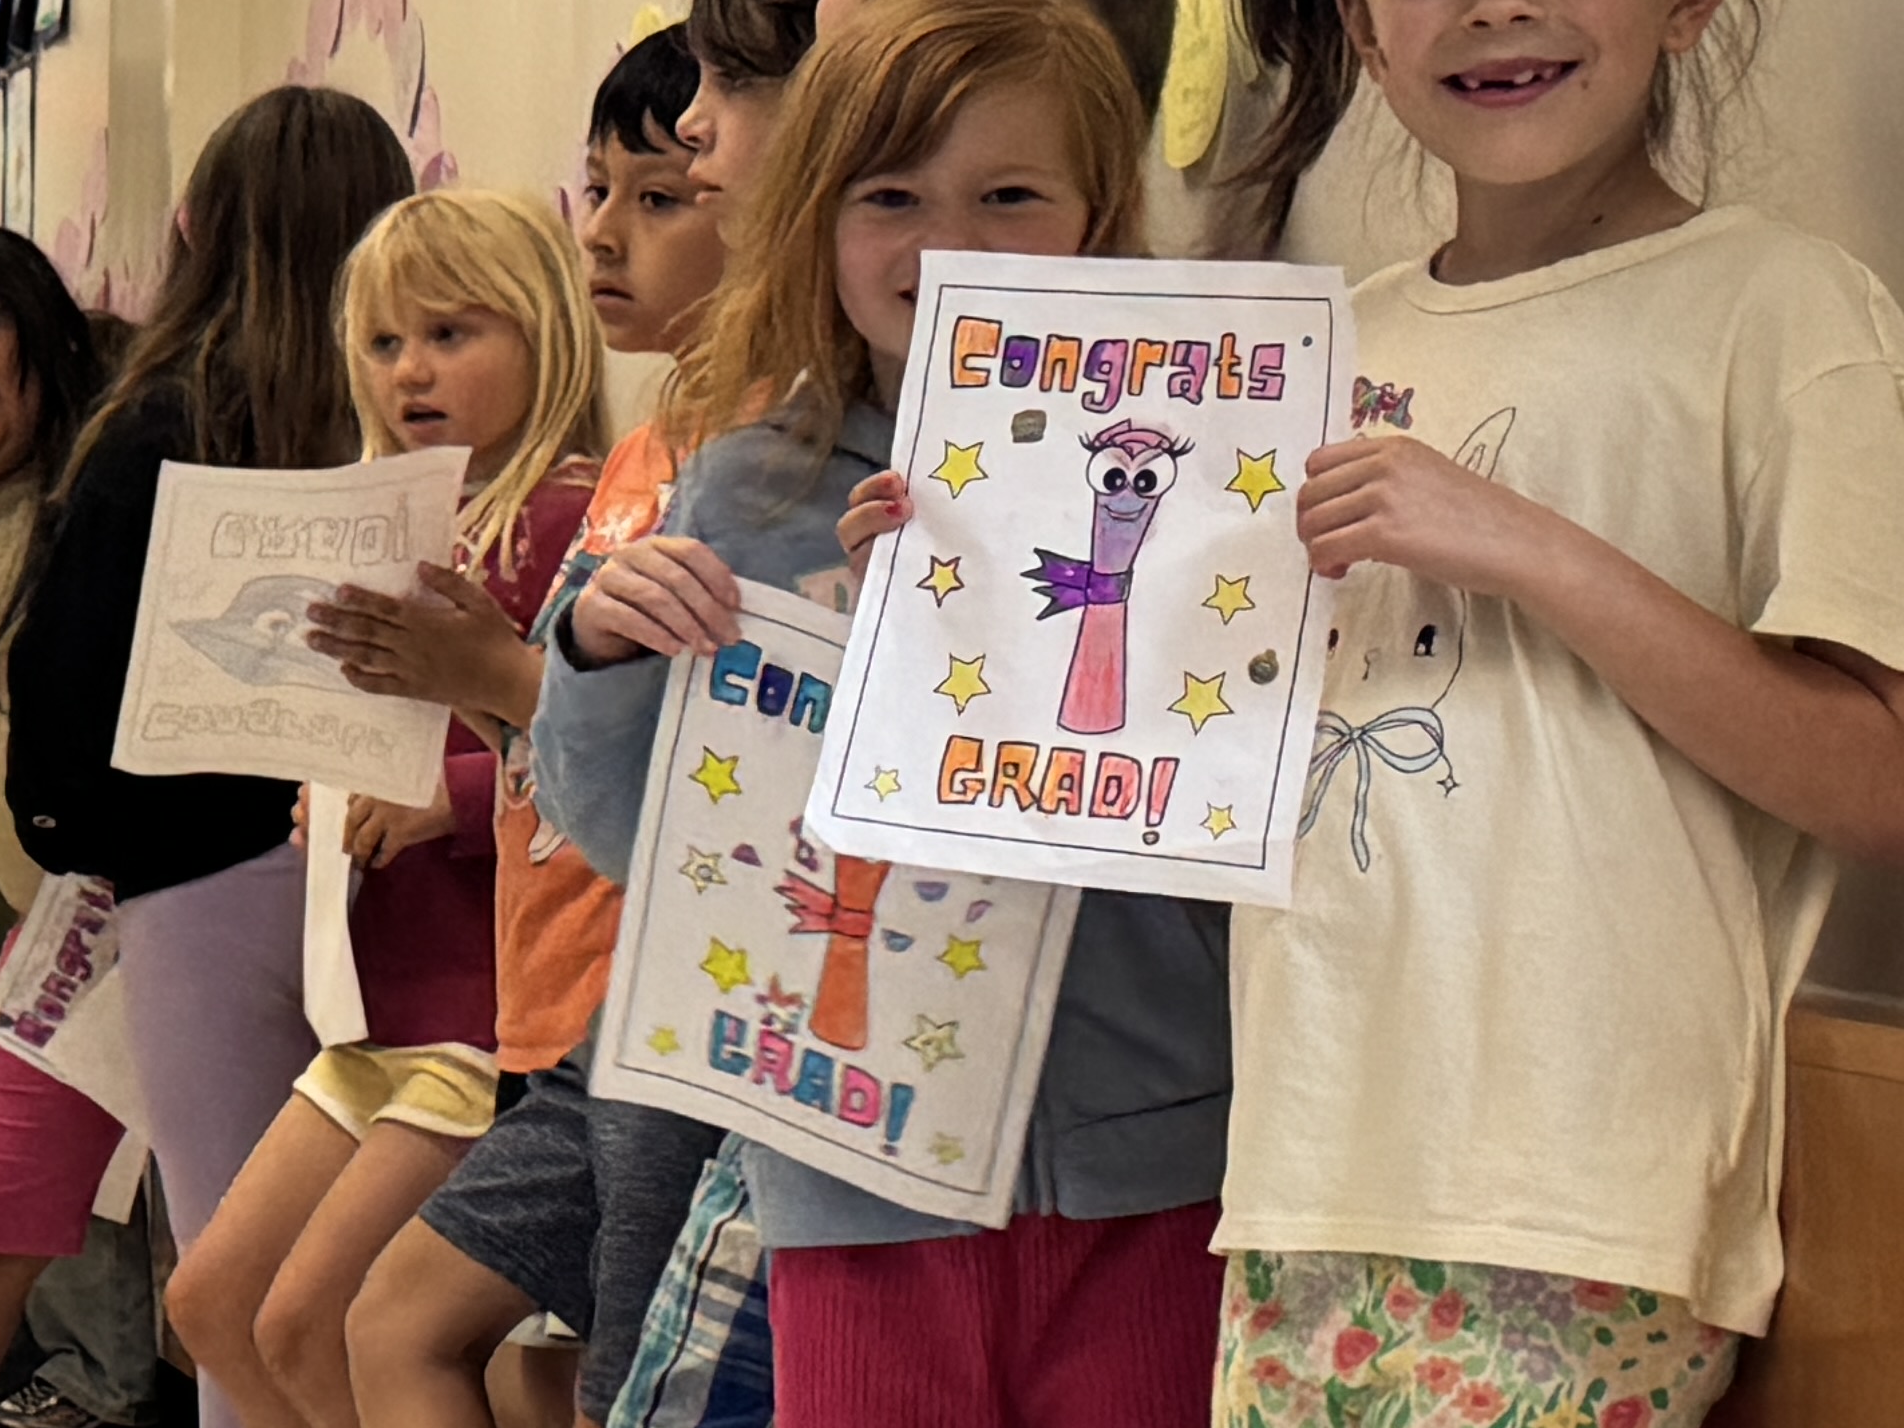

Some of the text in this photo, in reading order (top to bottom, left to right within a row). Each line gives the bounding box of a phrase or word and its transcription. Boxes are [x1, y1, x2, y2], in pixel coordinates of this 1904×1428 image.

[950, 314, 1286, 414] Congrats
[709, 639, 833, 734] Con
[937, 734, 1181, 846] GRAD!
[709, 1009, 915, 1157] GRAD!
